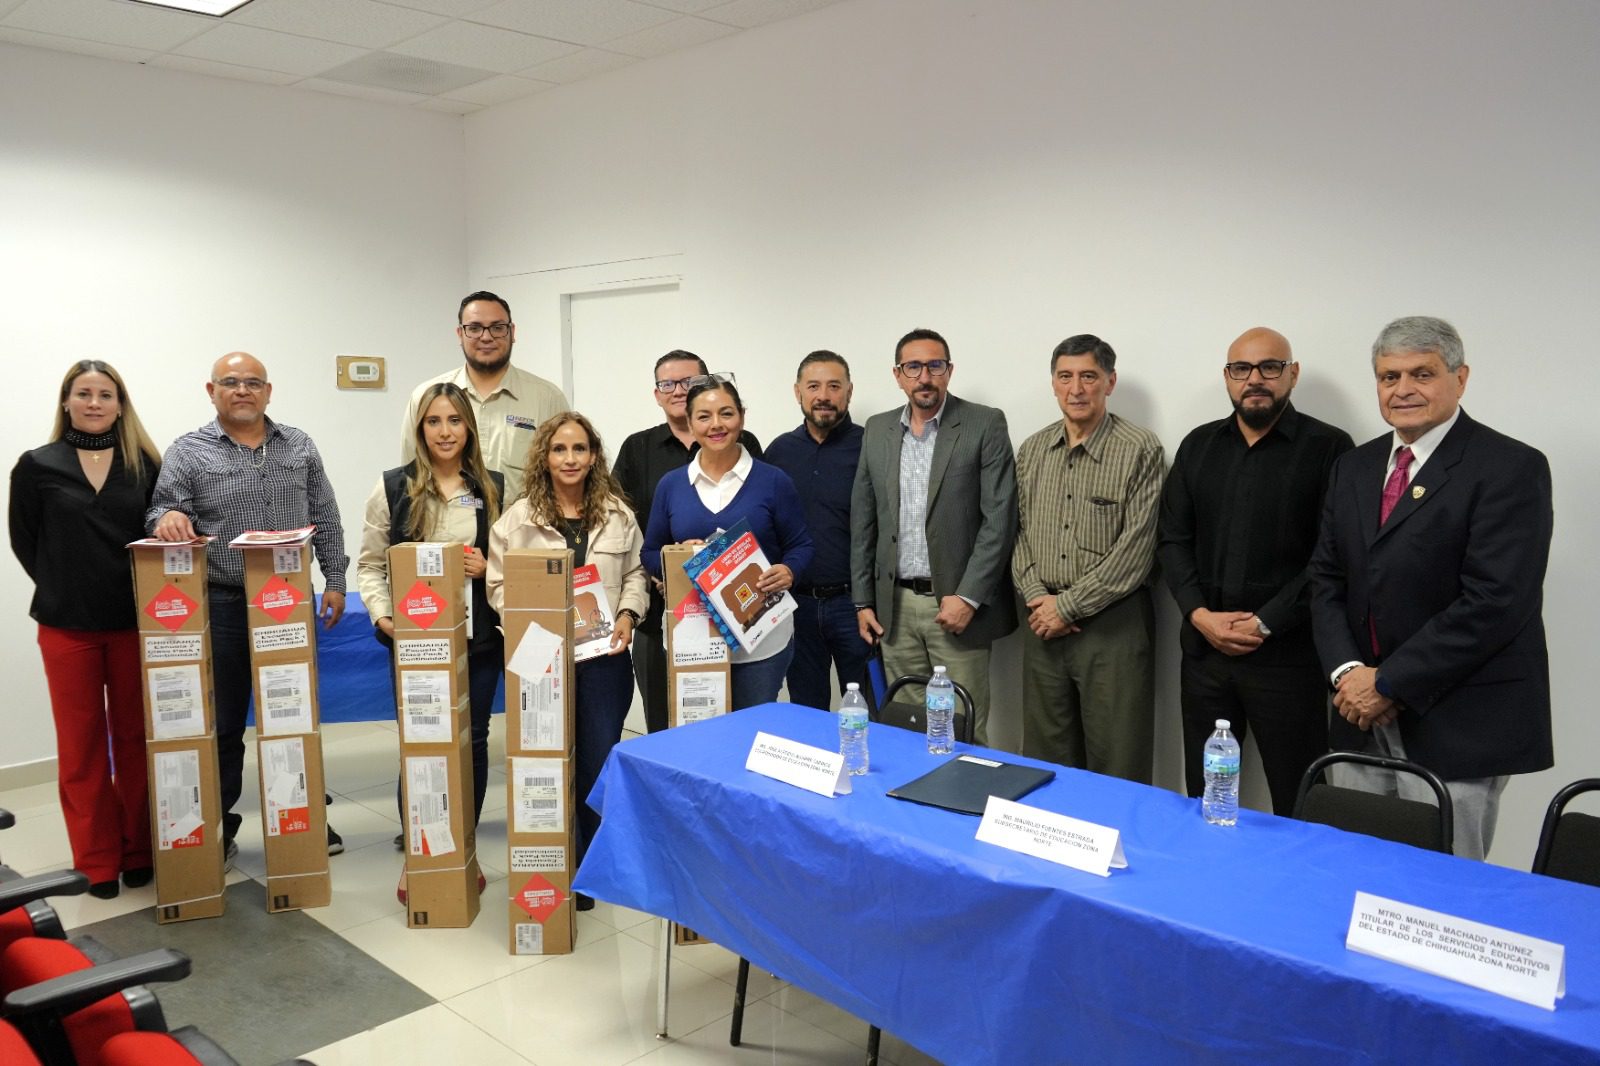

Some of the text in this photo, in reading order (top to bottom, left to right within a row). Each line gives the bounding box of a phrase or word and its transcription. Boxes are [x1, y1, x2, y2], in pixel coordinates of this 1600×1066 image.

[994, 819, 1039, 836] SUBSECRETARIO
[1082, 844, 1099, 852] ZONA
[1033, 837, 1052, 847] NORTE
[1042, 824, 1066, 836] FUENTES
[1067, 831, 1094, 844] ESTRADA
[1361, 913, 1550, 971] TITULAR DE LOS SERVICIOS EDUCATIVOS
[1378, 908, 1403, 920] MTRO.
[1406, 916, 1440, 931] MANUEL
[1443, 926, 1488, 944] MACHADO
[1359, 921, 1538, 978] DEL ESTADO DE CHIHUAHUA ZONA NORTE
